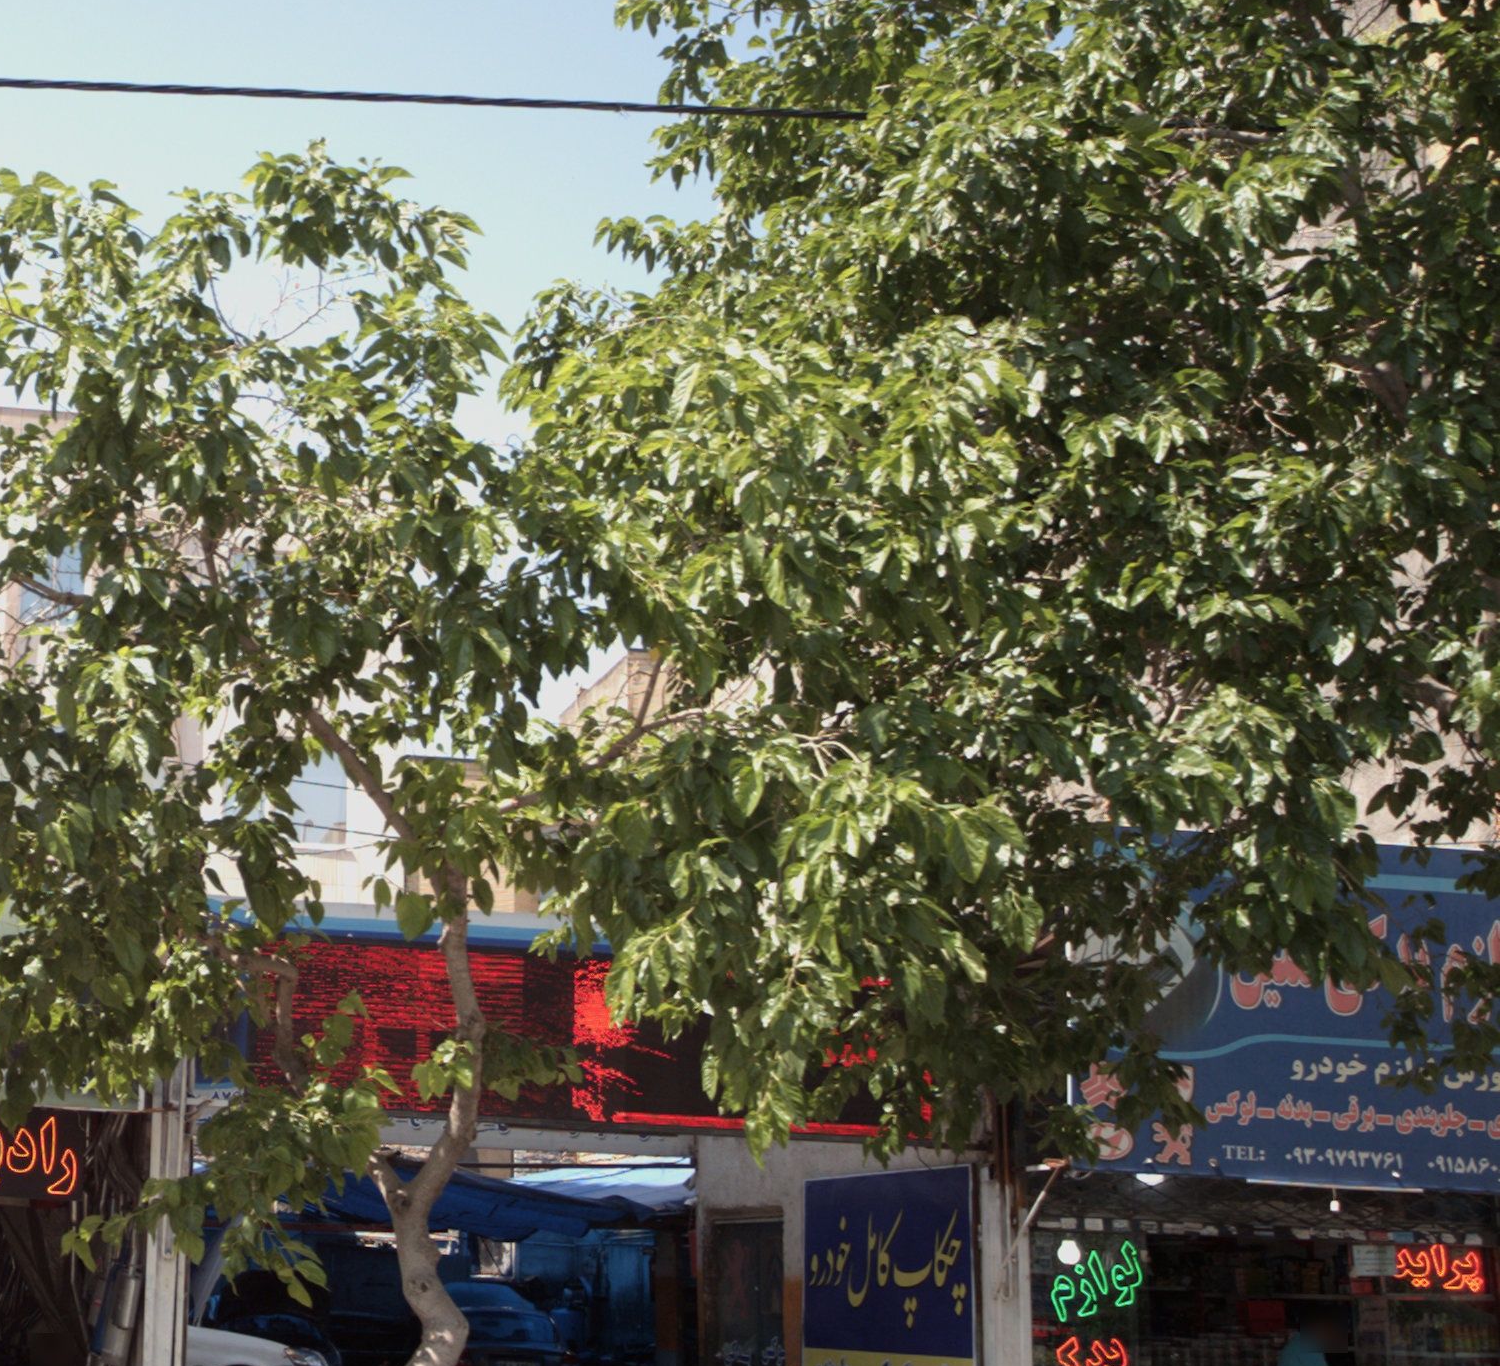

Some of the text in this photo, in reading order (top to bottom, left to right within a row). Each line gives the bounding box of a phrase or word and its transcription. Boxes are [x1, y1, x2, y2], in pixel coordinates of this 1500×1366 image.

[1290, 1052, 1367, 1083] خودرو
[1204, 1090, 1257, 1126] لوکس
[1276, 1093, 1313, 1128] بدنه
[1332, 1094, 1376, 1133] برقی
[1395, 1101, 1467, 1138] جلوبندی
[1222, 1144, 1266, 1162] TEL:
[1427, 1155, 1500, 1174] ۰۹۱۵۸۶۰
[809, 1208, 967, 1328] چکاپ کامل خودرو
[1050, 1240, 1144, 1323] لوازم
[1394, 1243, 1484, 1294] پراید
